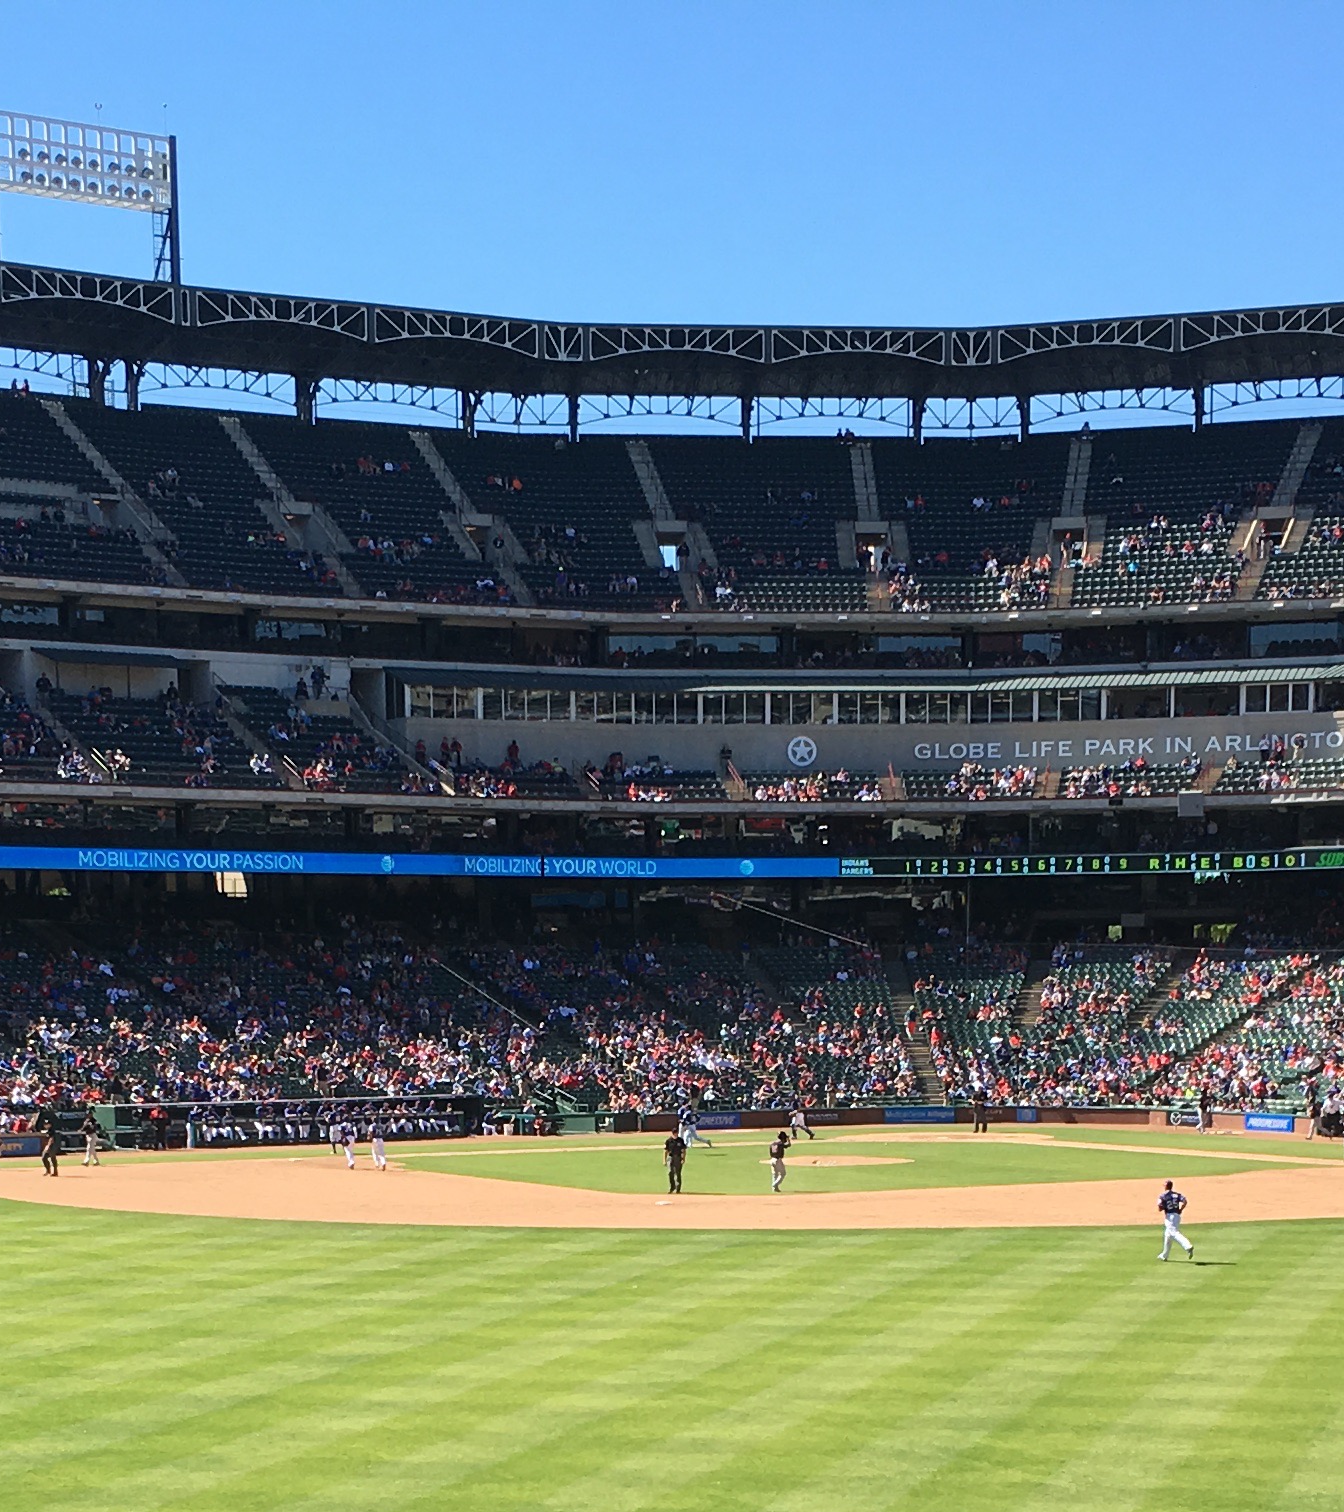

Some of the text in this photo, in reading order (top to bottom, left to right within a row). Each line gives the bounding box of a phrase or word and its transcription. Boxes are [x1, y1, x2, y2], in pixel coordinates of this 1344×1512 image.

[914, 742, 1002, 760] GLOBE
[1014, 740, 1072, 759] LIFE
[1084, 737, 1155, 757] PARK
[1165, 735, 1193, 753] IN
[78, 850, 304, 870] MOBILIZING YOUR PASSION
[464, 857, 657, 875] MOBILIZING YOUR WORLD
[905, 861, 910, 873] 1
[1149, 858, 1159, 869] R
[1175, 857, 1186, 869] H
[1201, 857, 1210, 868] E
